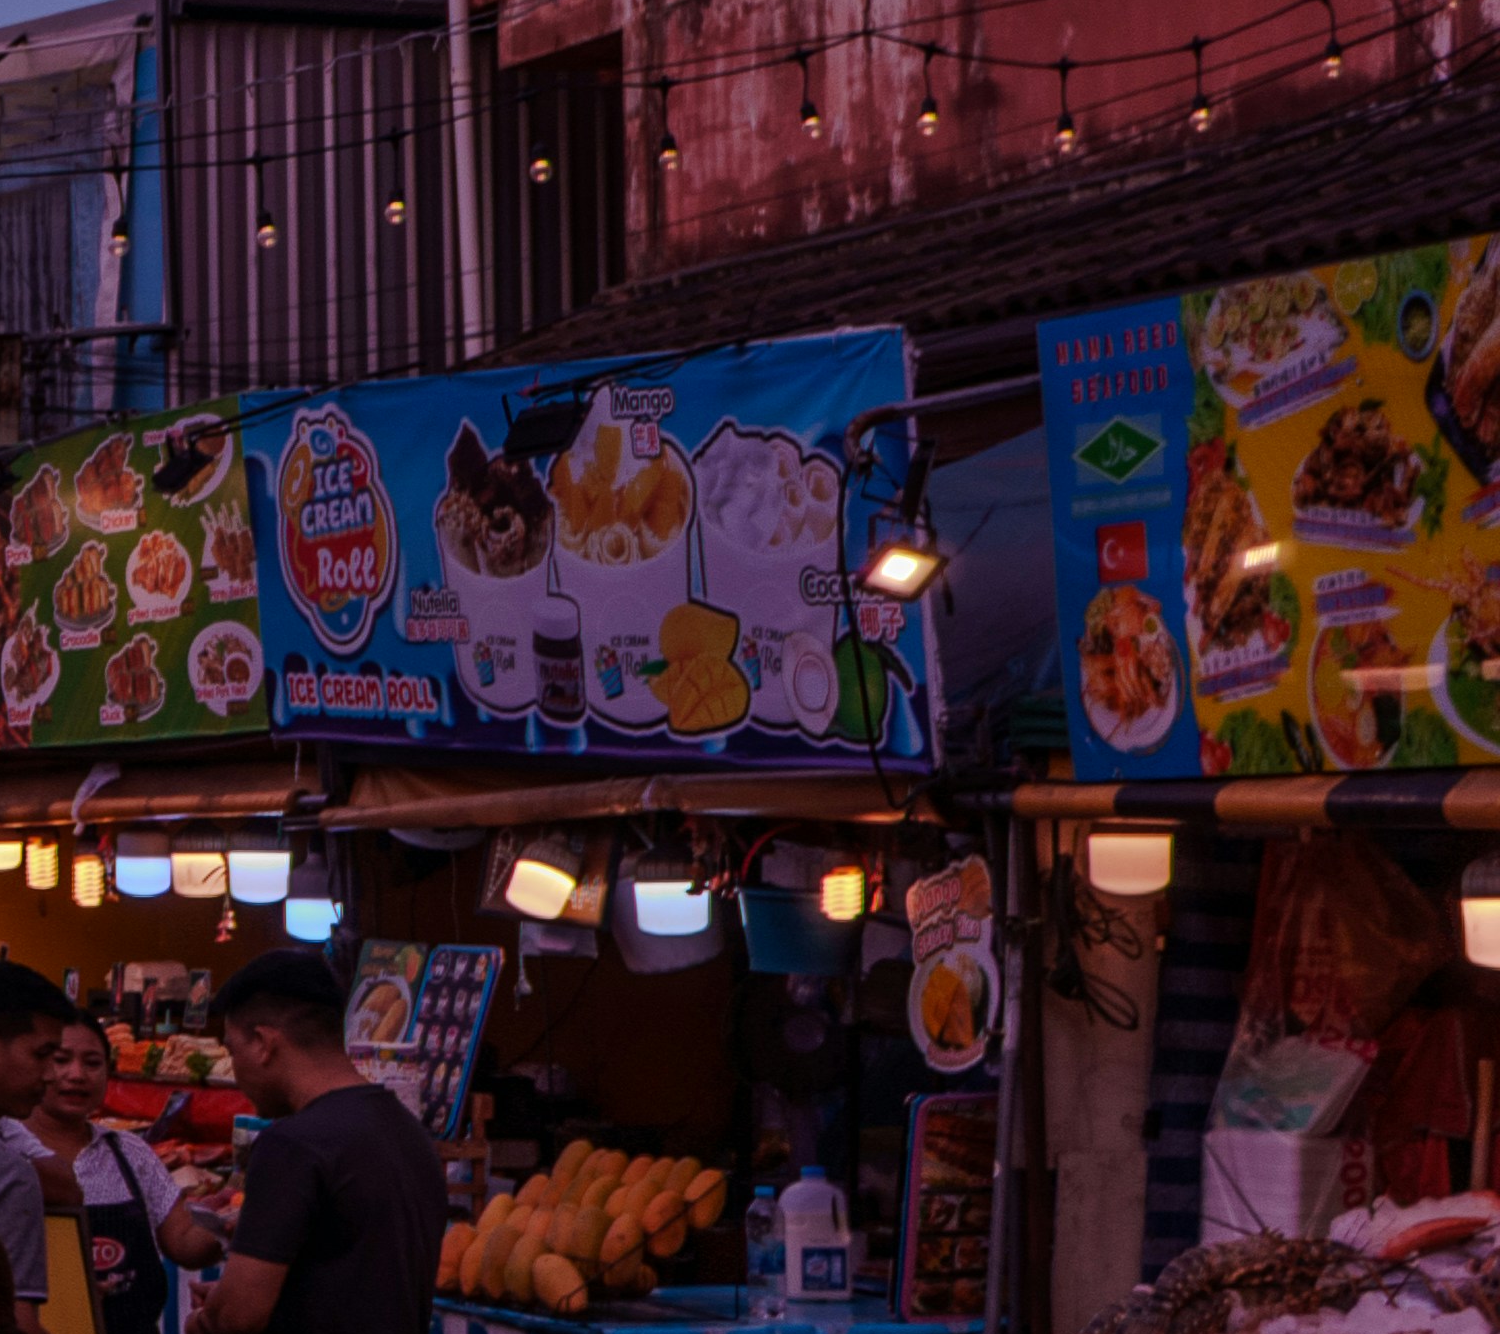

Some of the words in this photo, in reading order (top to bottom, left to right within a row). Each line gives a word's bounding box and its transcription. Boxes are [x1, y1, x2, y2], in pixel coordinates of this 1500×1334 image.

[613, 388, 672, 416] Mango
[1070, 362, 1170, 406] SEAFOOD
[313, 460, 353, 497] ICE
[300, 490, 375, 537] CREAM
[316, 546, 379, 592] Roll
[410, 593, 458, 614] Nutella
[289, 676, 318, 706] ICE
[320, 676, 383, 708] CREAM
[386, 678, 436, 710] ROLL
